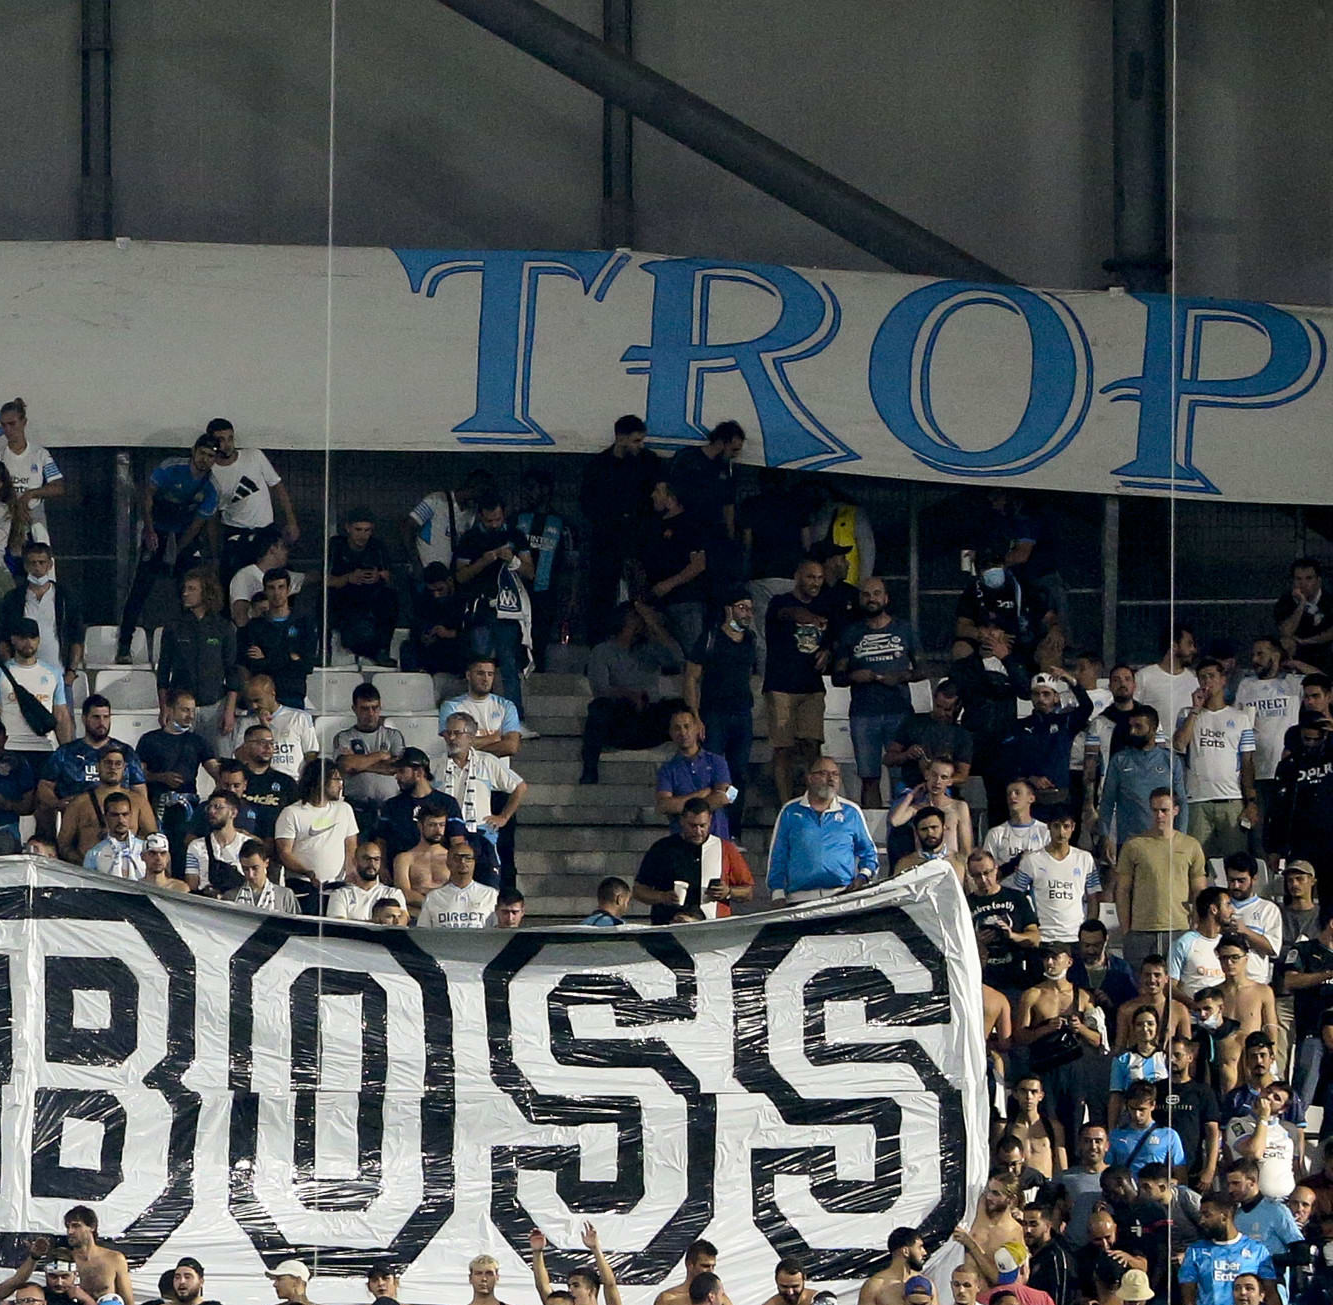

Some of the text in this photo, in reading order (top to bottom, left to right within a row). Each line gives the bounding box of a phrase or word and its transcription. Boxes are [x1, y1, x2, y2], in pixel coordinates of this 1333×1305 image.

[390, 246, 1332, 496] TROP
[1200, 728, 1226, 738] Uber
[1200, 738, 1226, 748] Eats
[1047, 880, 1073, 890] Uber
[1048, 890, 1073, 901] Eats
[1213, 1260, 1240, 1271] Uber
